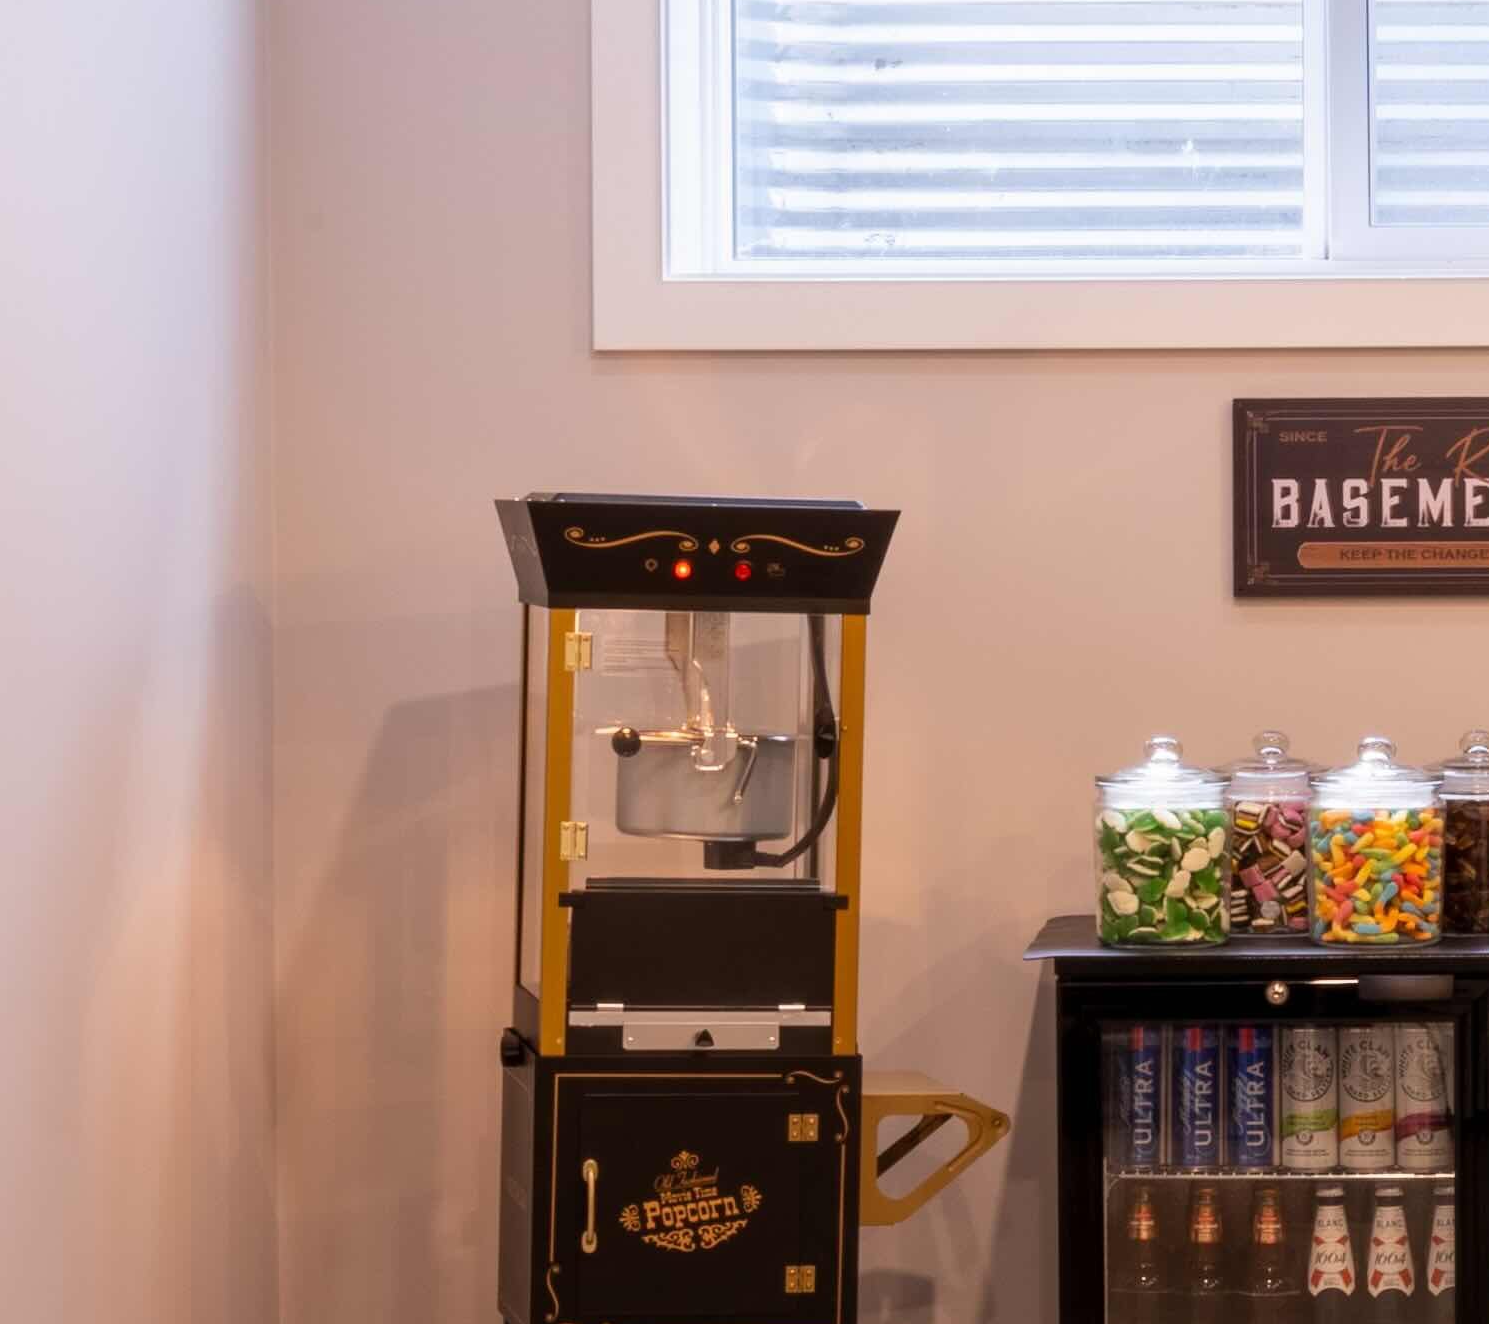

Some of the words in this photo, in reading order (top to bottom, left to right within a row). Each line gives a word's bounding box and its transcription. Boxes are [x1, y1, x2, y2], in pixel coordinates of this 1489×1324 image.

[1279, 431, 1327, 443] SINCE
[1354, 425, 1423, 488] The
[1340, 549, 1381, 560] KEEP
[1387, 549, 1417, 560] THE
[1134, 1060, 1152, 1145] ULTRA
[1194, 1061, 1213, 1146] ULTRA
[1246, 1061, 1264, 1146] ULTRA
[642, 1197, 740, 1229] Popcorn
